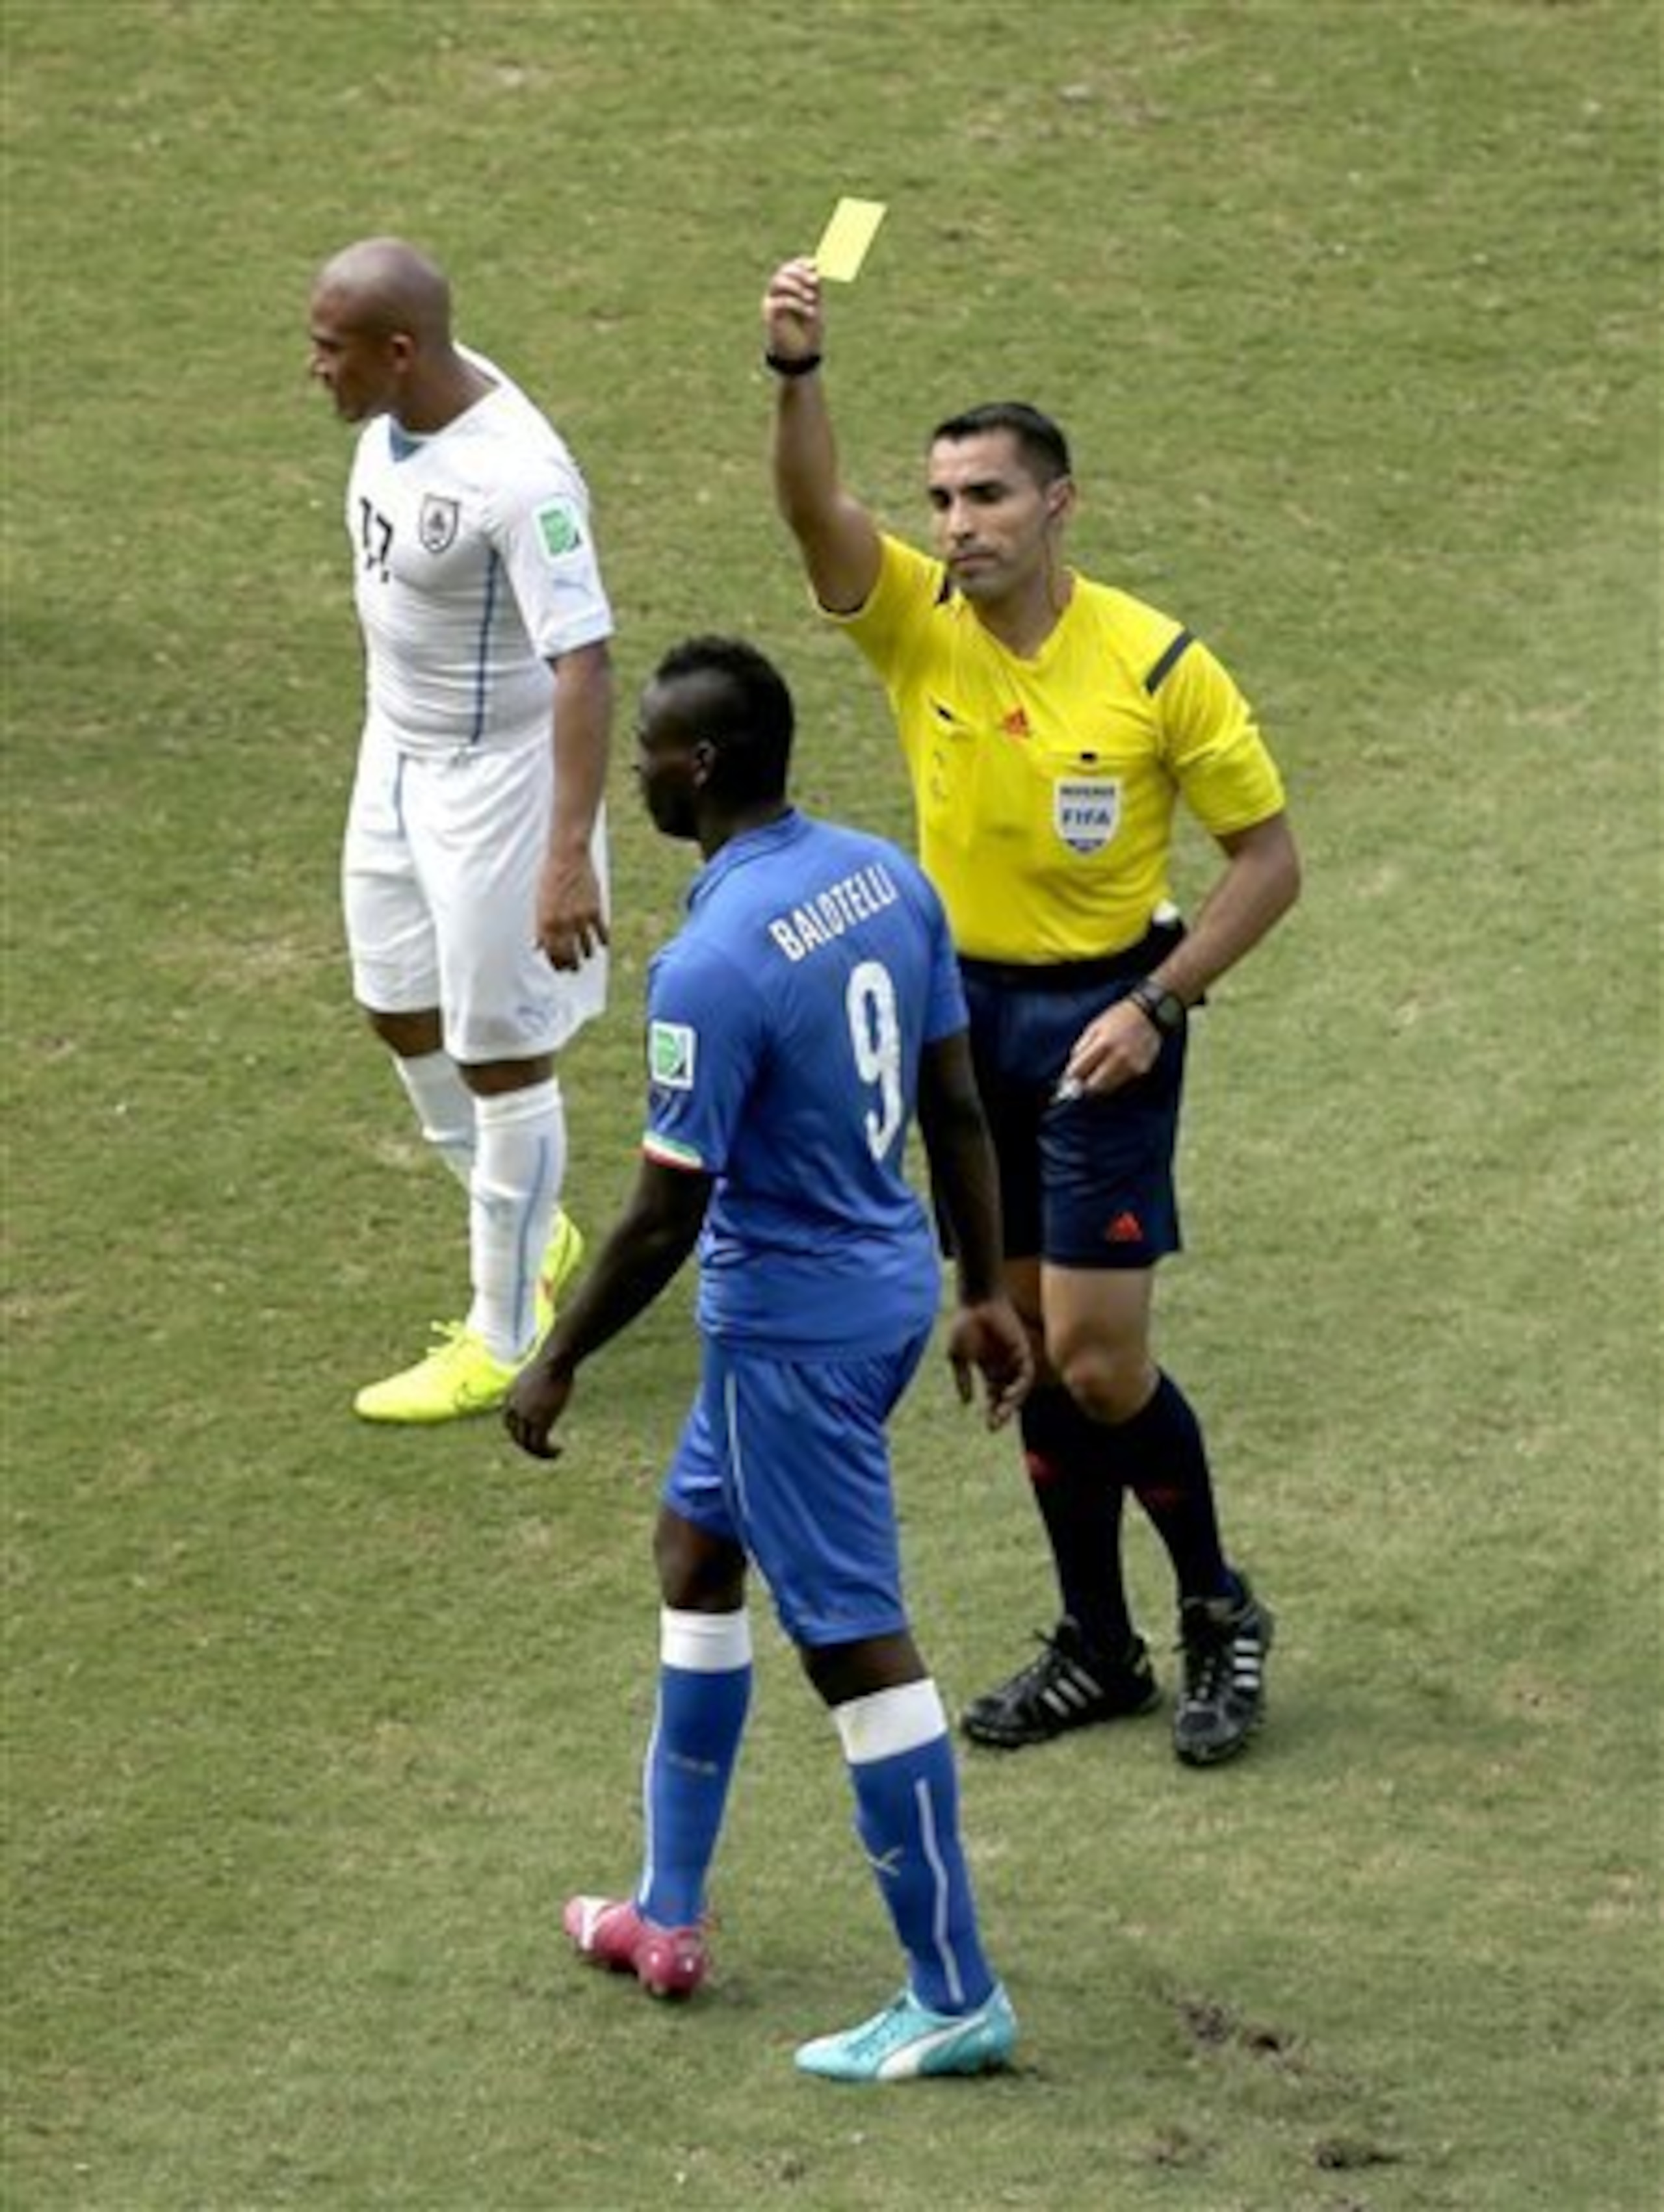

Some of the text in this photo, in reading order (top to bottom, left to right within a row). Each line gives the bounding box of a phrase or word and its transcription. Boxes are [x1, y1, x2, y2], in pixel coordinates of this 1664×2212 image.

[1062, 808, 1111, 825] FIFA
[768, 862, 898, 961] BALOTELLI
[846, 960, 901, 1161] 9
